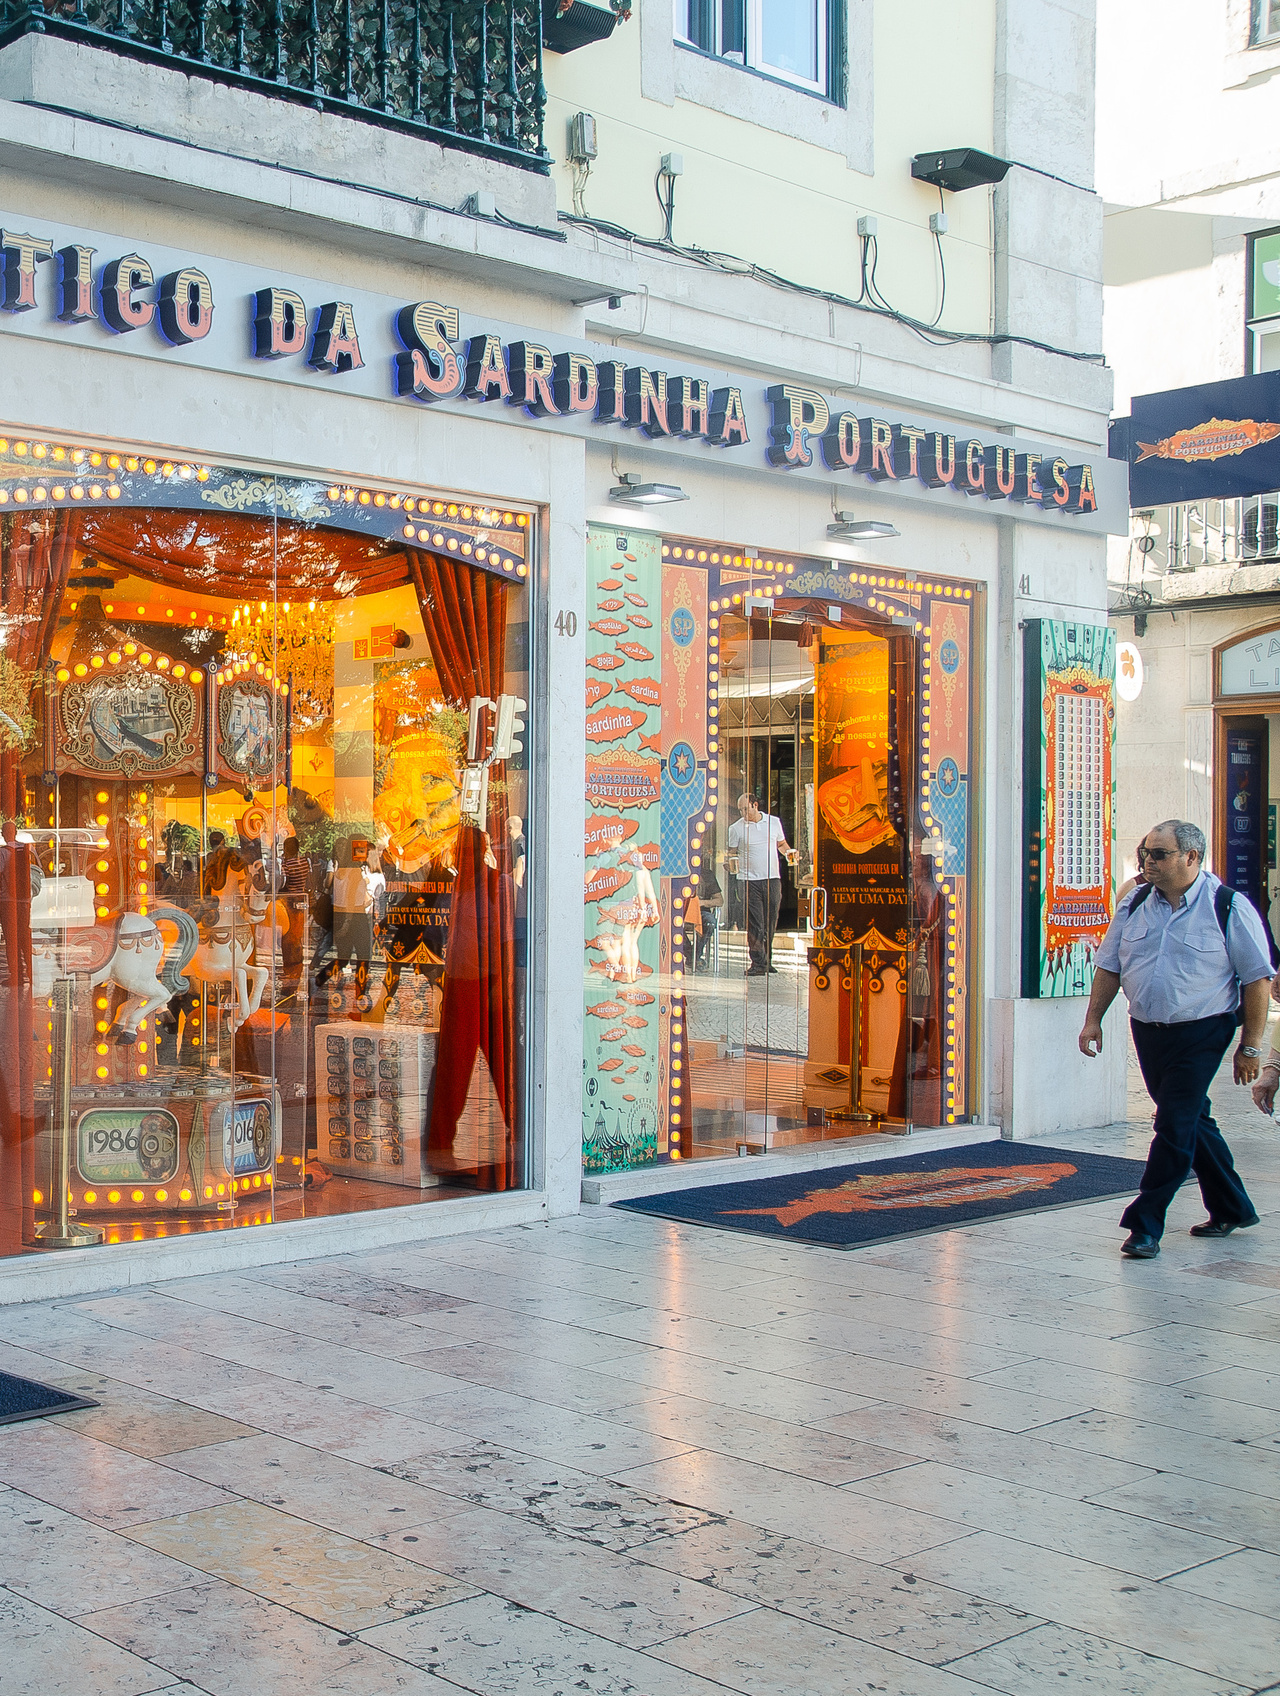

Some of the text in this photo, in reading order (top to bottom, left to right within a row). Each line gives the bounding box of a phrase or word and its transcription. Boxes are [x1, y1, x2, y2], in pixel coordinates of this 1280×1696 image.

[253, 287, 365, 374] DA
[396, 302, 749, 447] SARDINHA
[765, 384, 1100, 516] PORTUGUESA
[1018, 574, 1032, 596] 41
[553, 610, 577, 637] 40
[631, 684, 659, 699] sardina
[586, 714, 632, 734] sardinha
[589, 773, 651, 786] SARDINHA
[584, 823, 624, 844] sardine
[832, 893, 856, 904] TEM
[859, 893, 885, 905] UMA
[1052, 903, 1105, 914] SARDINHA
[386, 913, 407, 925] TEM
[409, 914, 432, 926] UMA
[88, 1128, 139, 1154] 1986
[227, 1119, 253, 1145] 2016
